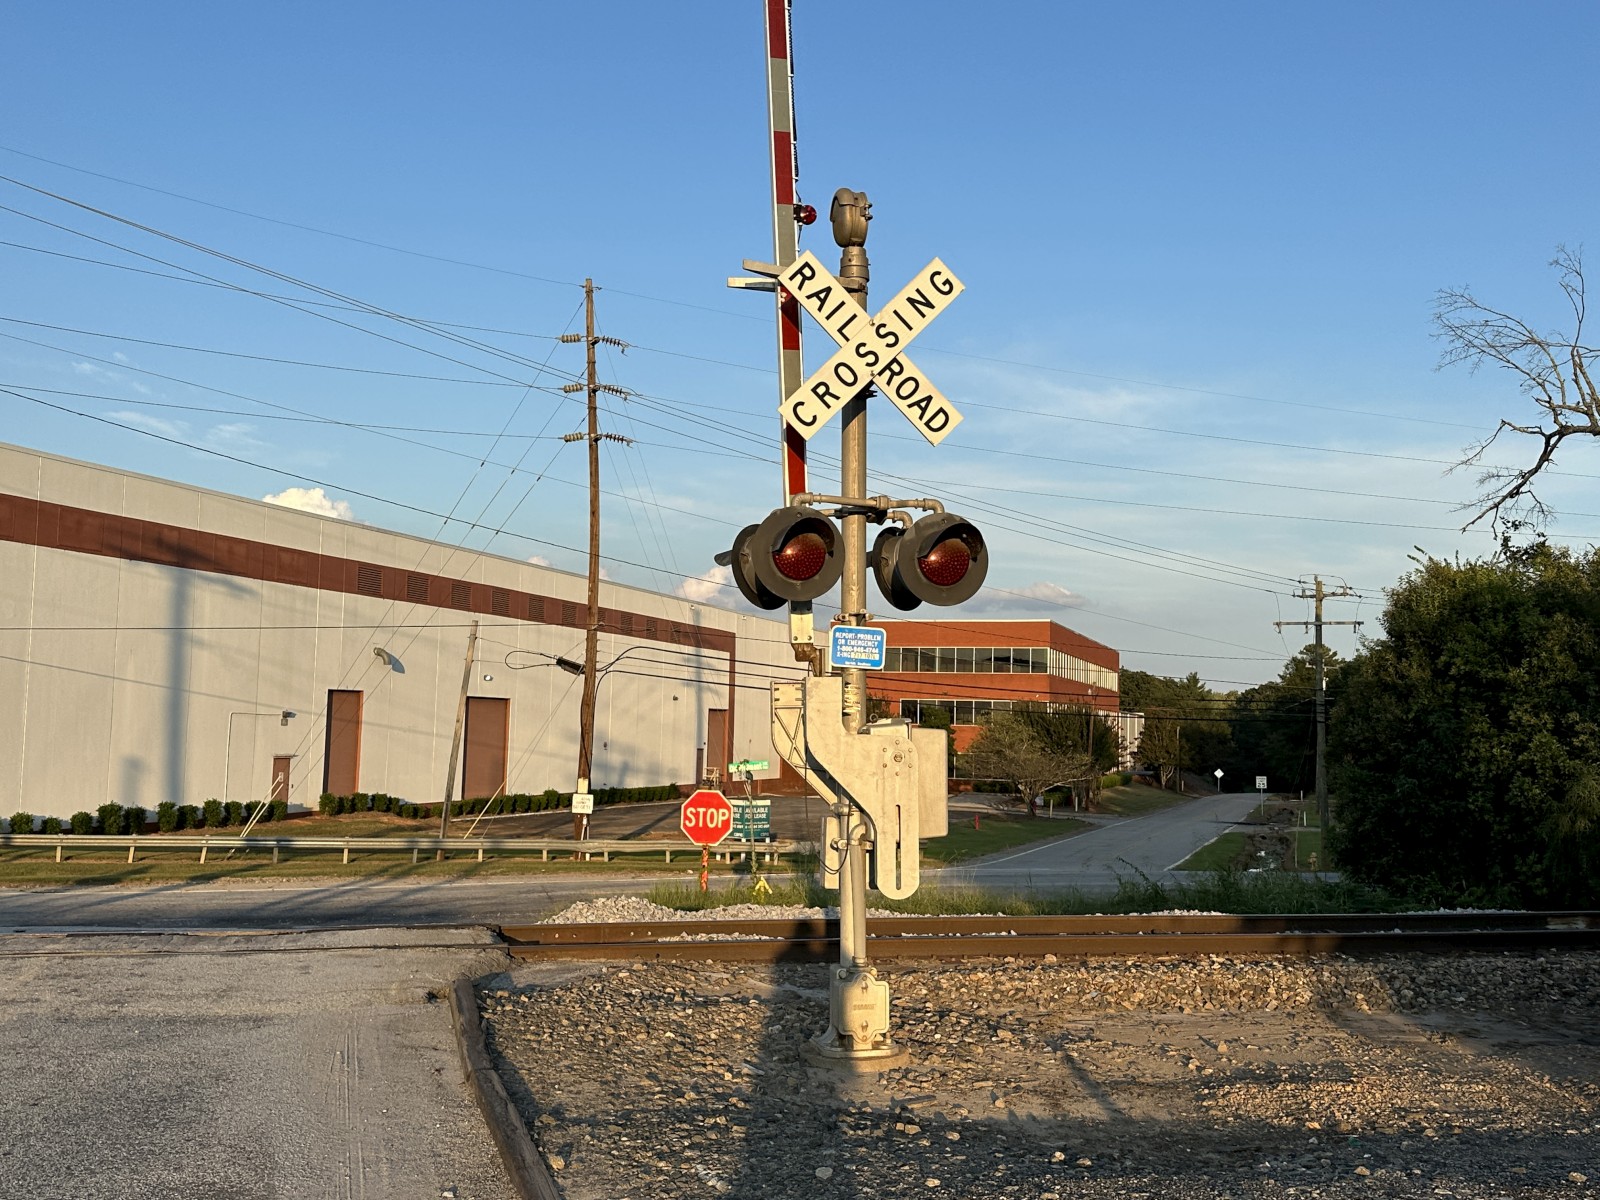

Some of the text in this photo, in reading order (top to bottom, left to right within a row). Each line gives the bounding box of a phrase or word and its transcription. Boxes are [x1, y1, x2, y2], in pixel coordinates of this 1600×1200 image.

[788, 261, 950, 433] RAIL ROAD
[792, 270, 954, 427] CROSSING
[847, 639, 878, 647] EMERGENCY
[685, 807, 729, 829] STOP
